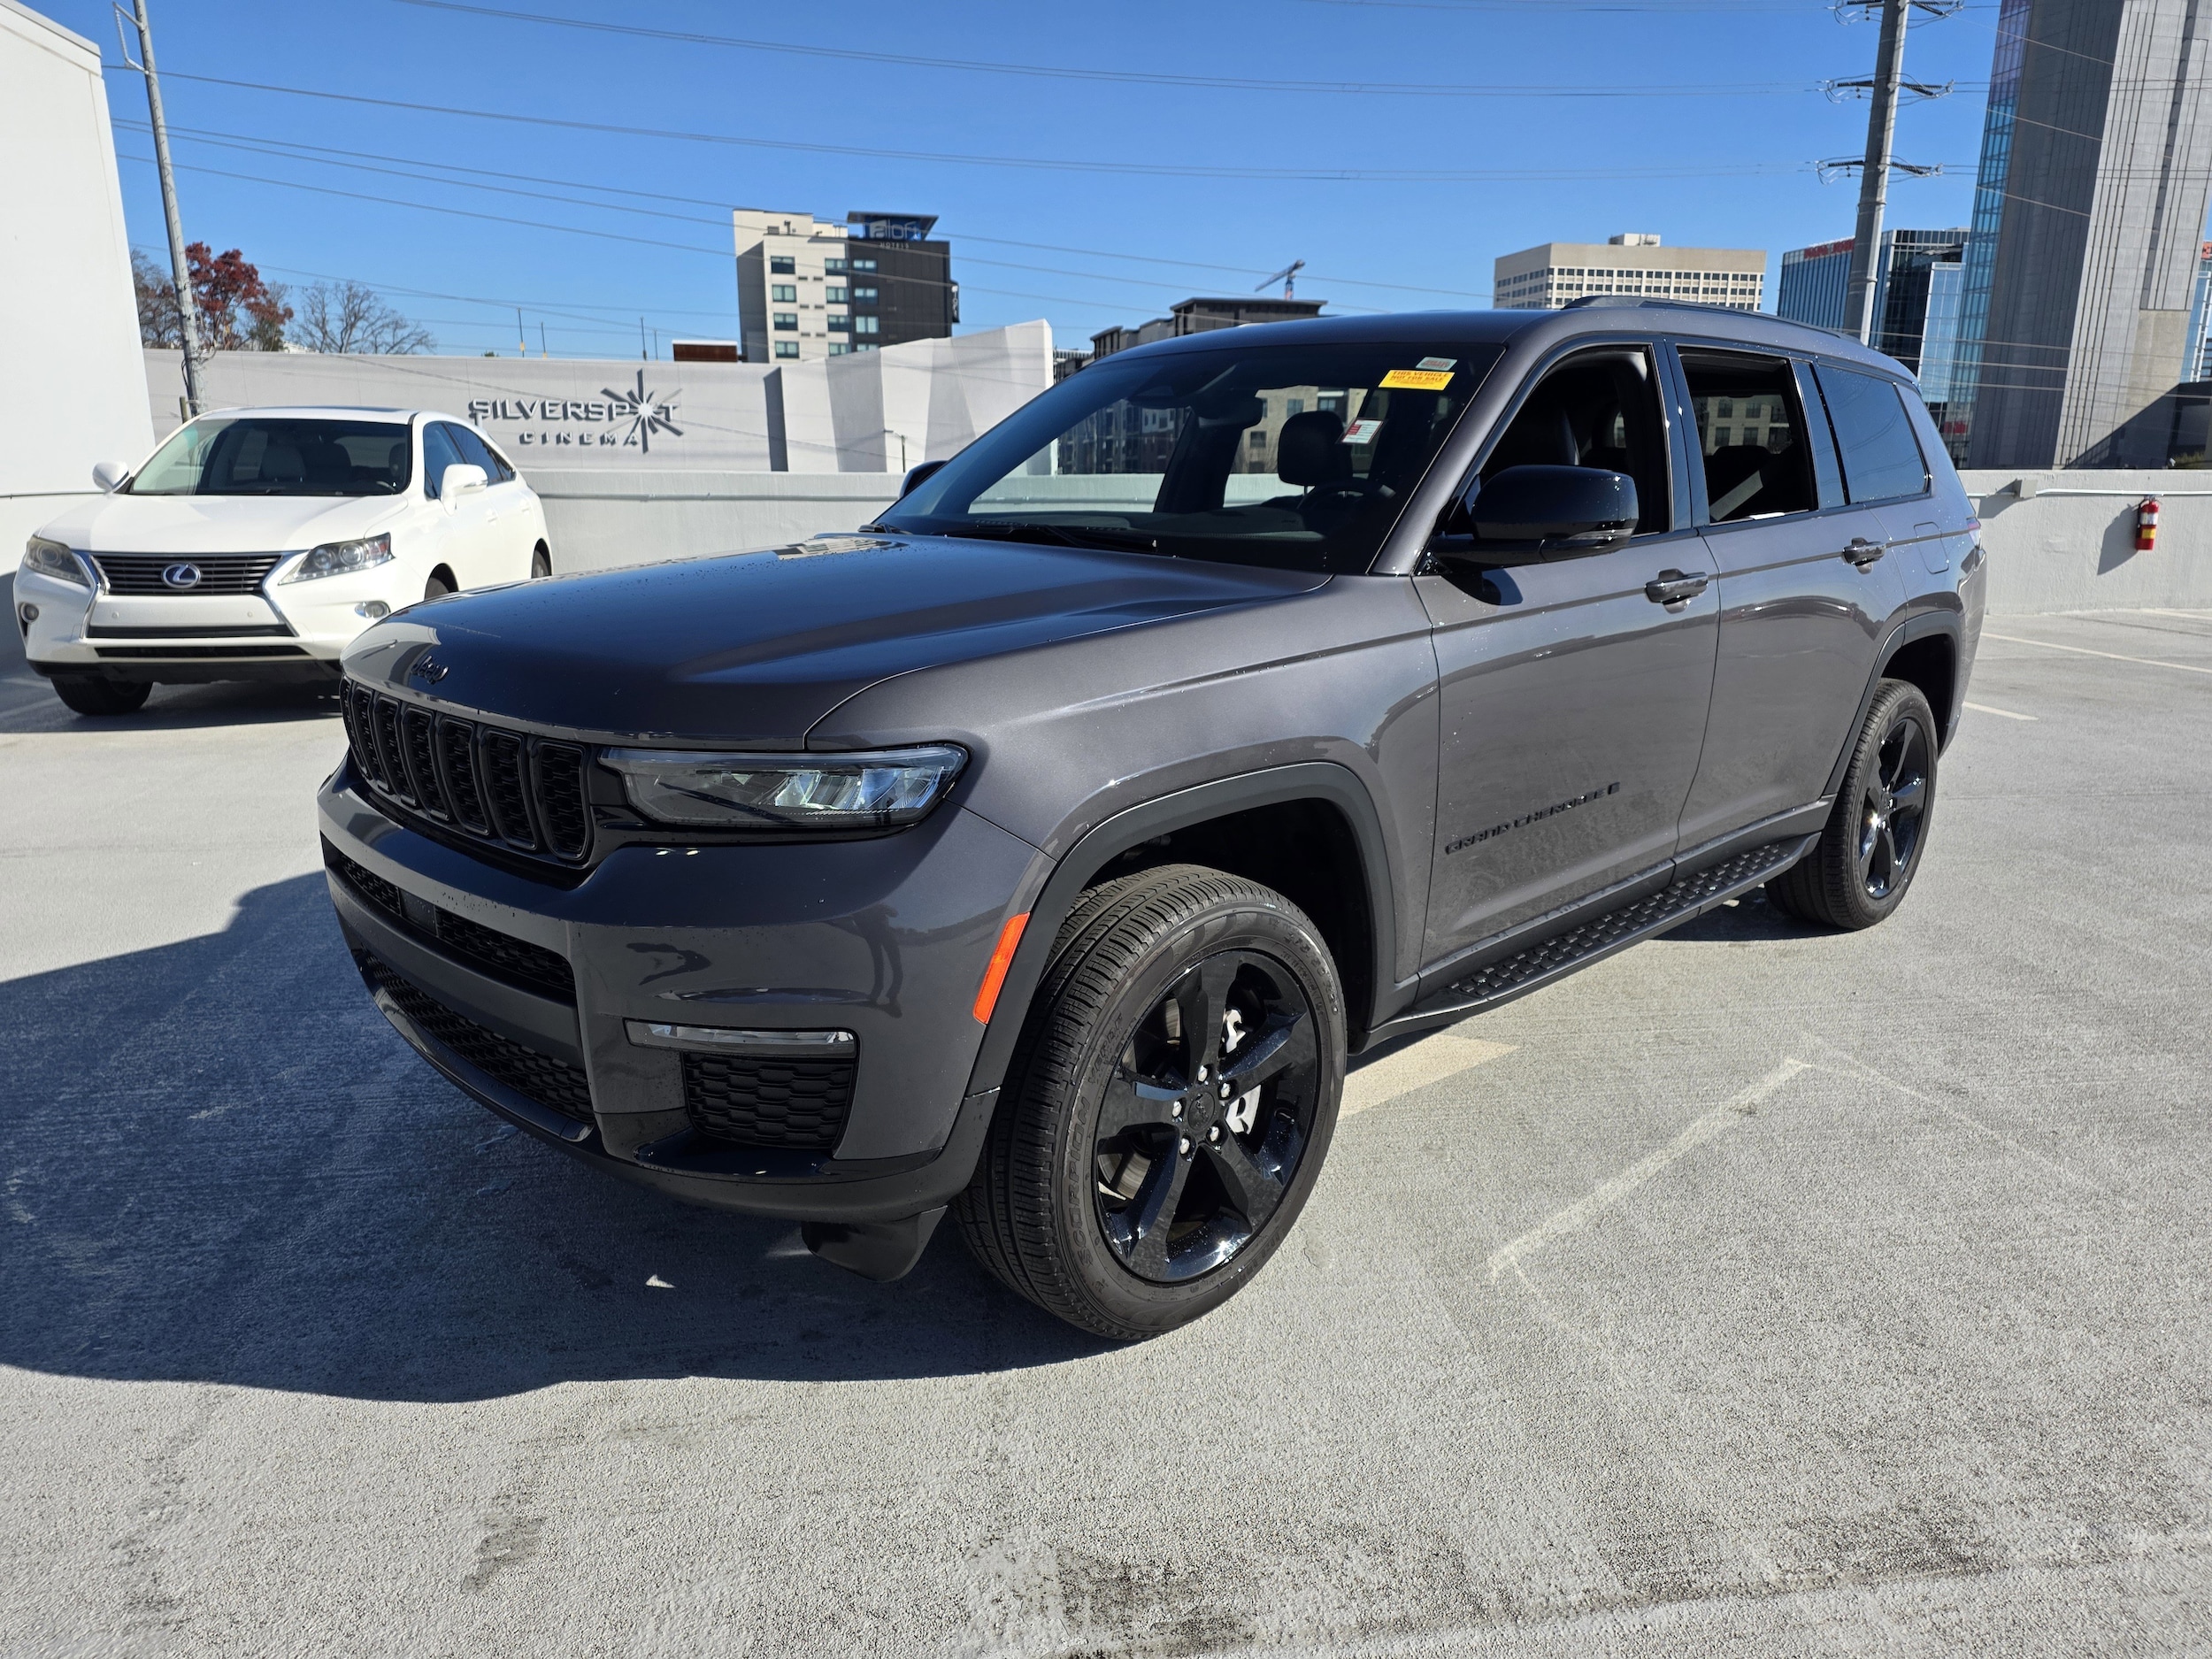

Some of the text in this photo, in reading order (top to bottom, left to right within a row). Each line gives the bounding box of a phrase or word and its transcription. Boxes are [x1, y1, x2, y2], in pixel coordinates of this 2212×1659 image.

[520, 431, 640, 445] CINEMA
[1444, 822, 1510, 855] GRAND
[1068, 1095, 1093, 1267] SCORPION
